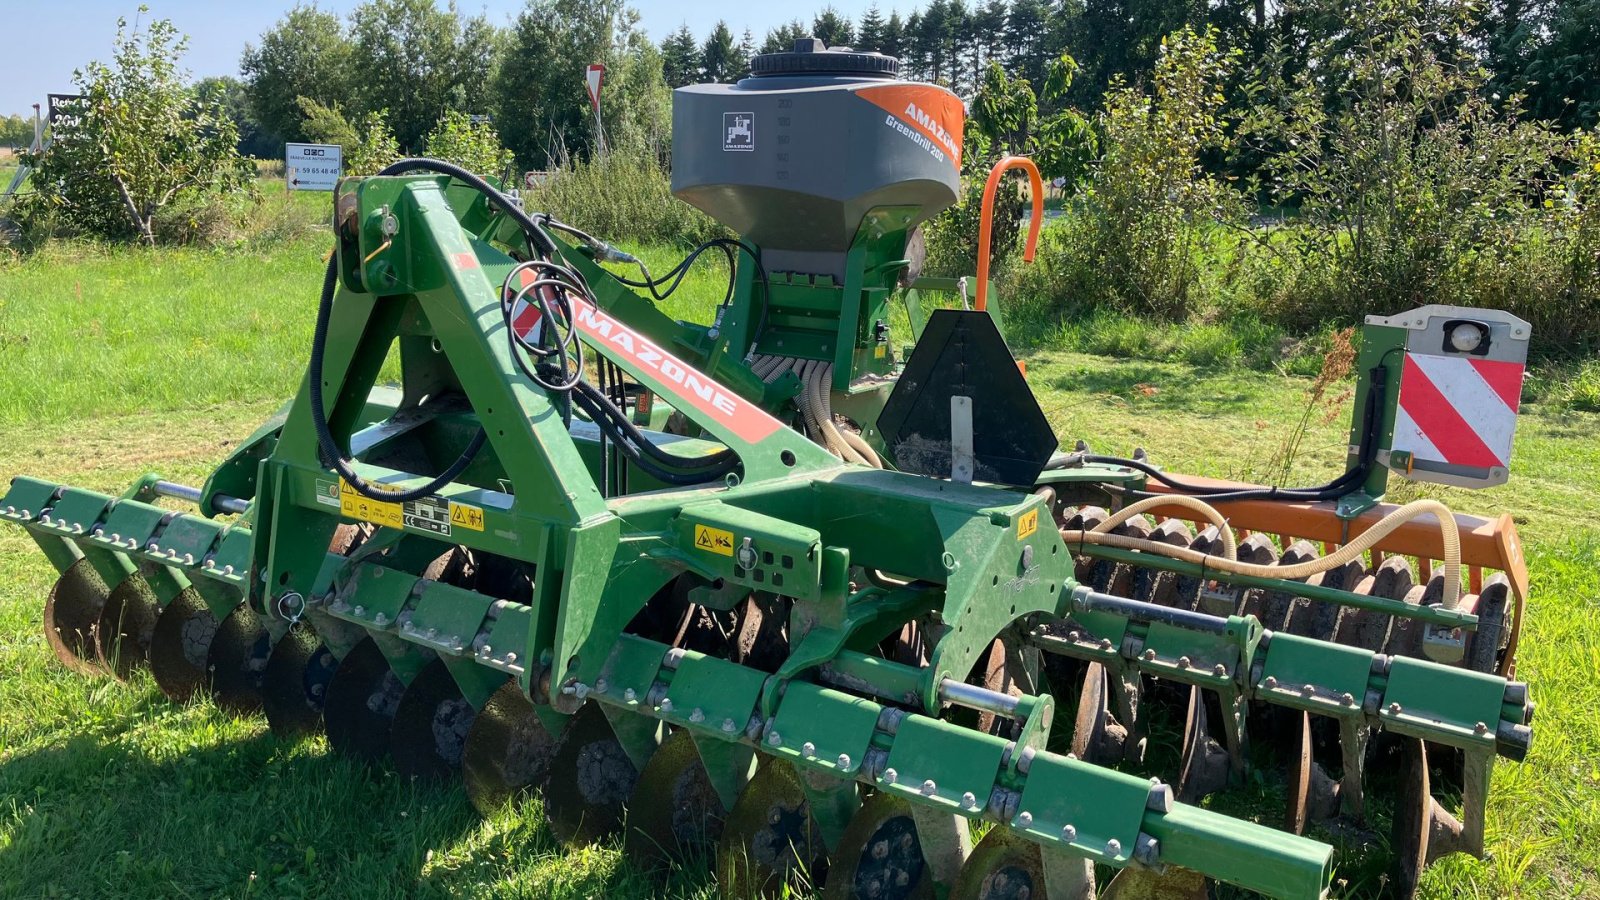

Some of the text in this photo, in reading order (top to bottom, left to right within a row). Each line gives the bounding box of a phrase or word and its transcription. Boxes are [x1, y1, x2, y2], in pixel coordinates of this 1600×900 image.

[885, 114, 944, 162] GreenDrill 200
[904, 102, 960, 161] AMAZONE
[550, 298, 737, 416] MAZONE
